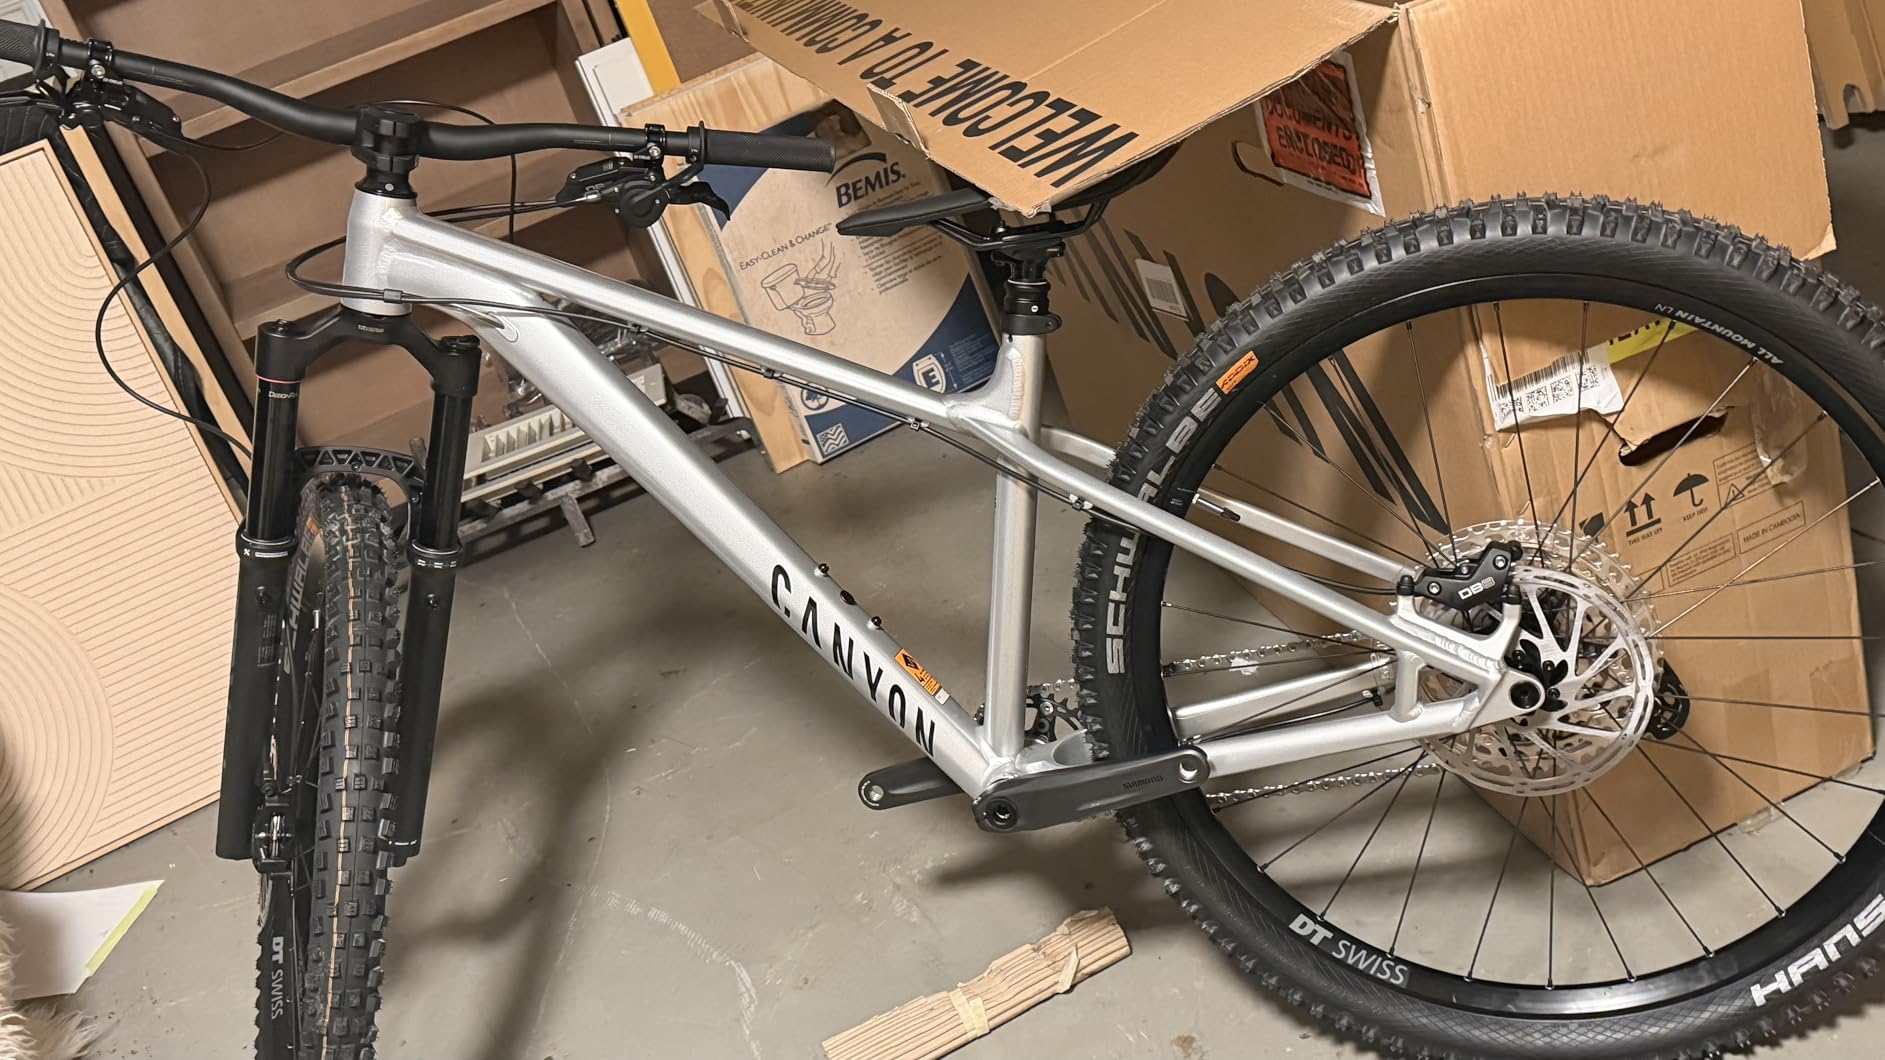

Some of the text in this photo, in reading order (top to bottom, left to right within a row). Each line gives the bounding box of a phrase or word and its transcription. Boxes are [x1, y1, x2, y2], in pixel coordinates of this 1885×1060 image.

[837, 27, 913, 65] A
[859, 41, 950, 90] TO
[902, 58, 1140, 188] WELCOME
[789, 239, 796, 248] &
[1655, 303, 1674, 314] LN
[1675, 310, 1756, 349] MOUNTAIN
[1758, 347, 1784, 364] ALL
[1743, 530, 1760, 543] MADE
[771, 564, 936, 757] CANYON
[1288, 913, 1408, 985] DT SWISS
[1750, 893, 1885, 1007] HANS
[271, 936, 284, 1020] DT SWISS
